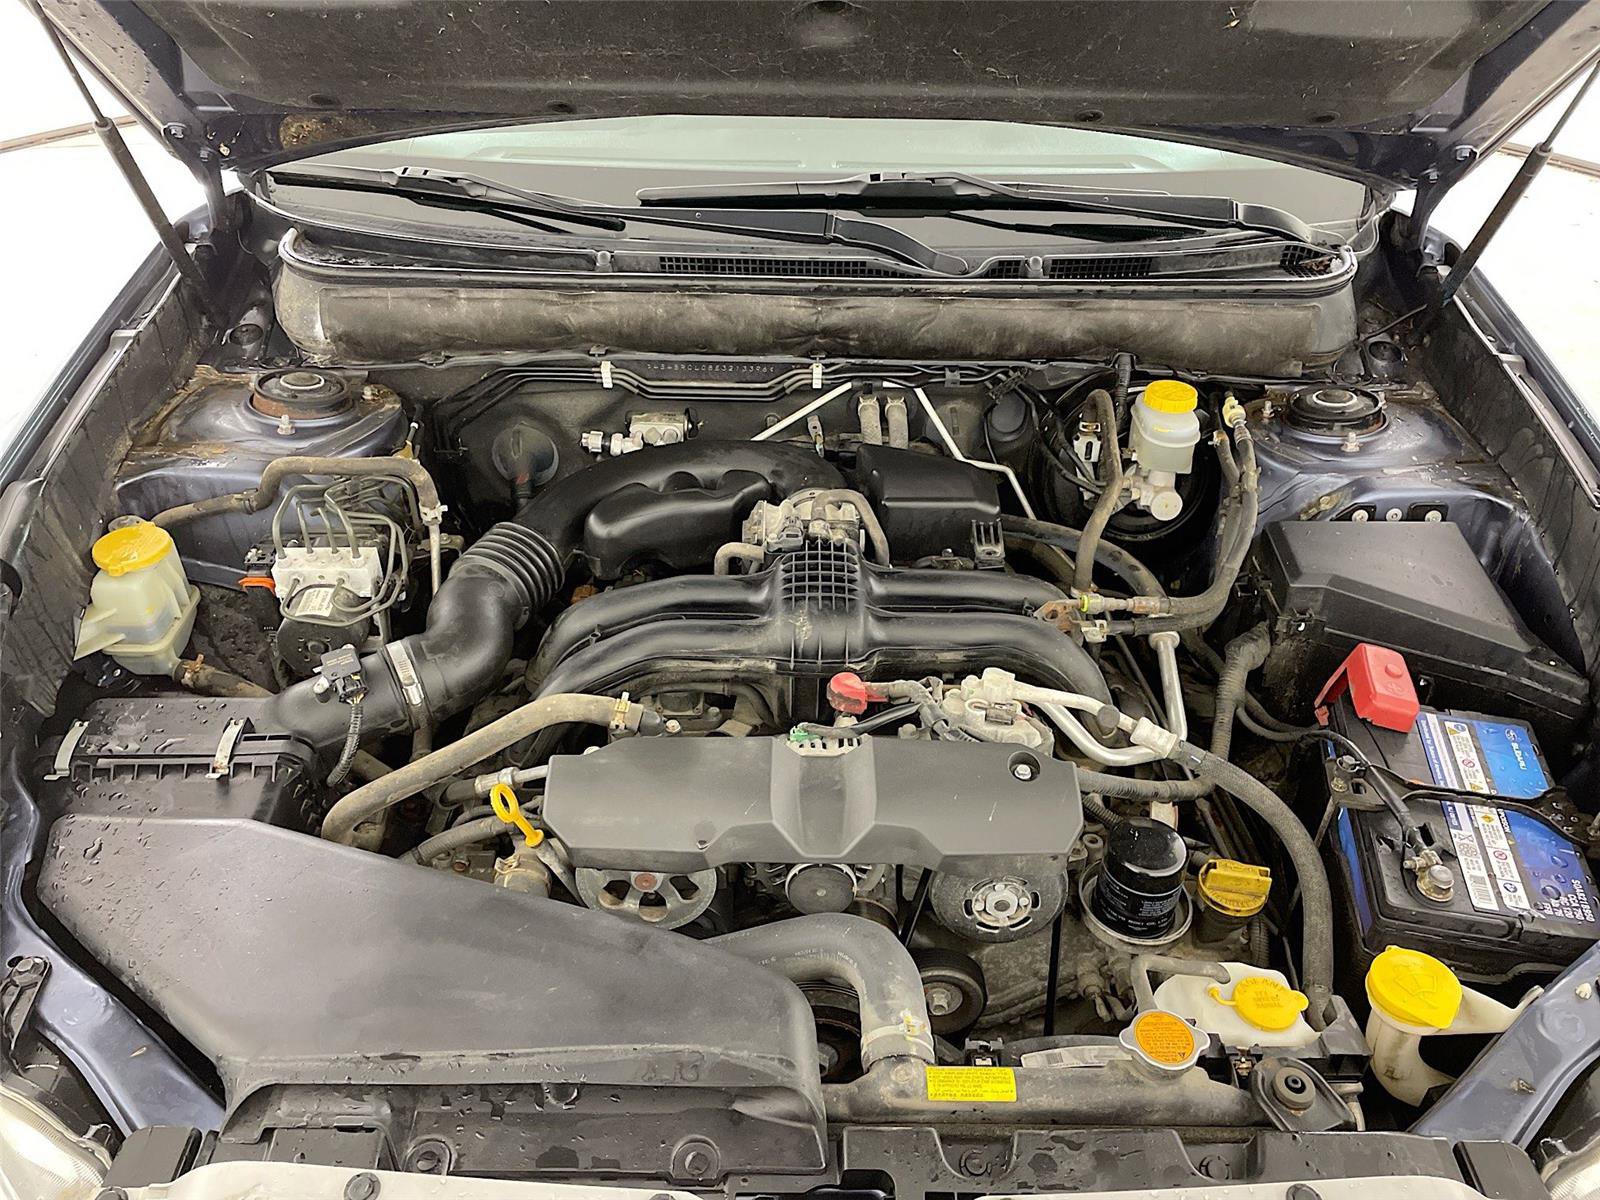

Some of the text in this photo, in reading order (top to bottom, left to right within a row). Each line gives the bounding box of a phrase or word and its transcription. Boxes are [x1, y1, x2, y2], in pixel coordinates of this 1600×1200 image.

[1511, 742, 1528, 770] SUBARU
[1567, 894, 1580, 907] CCA
[1563, 907, 1575, 919] 120
